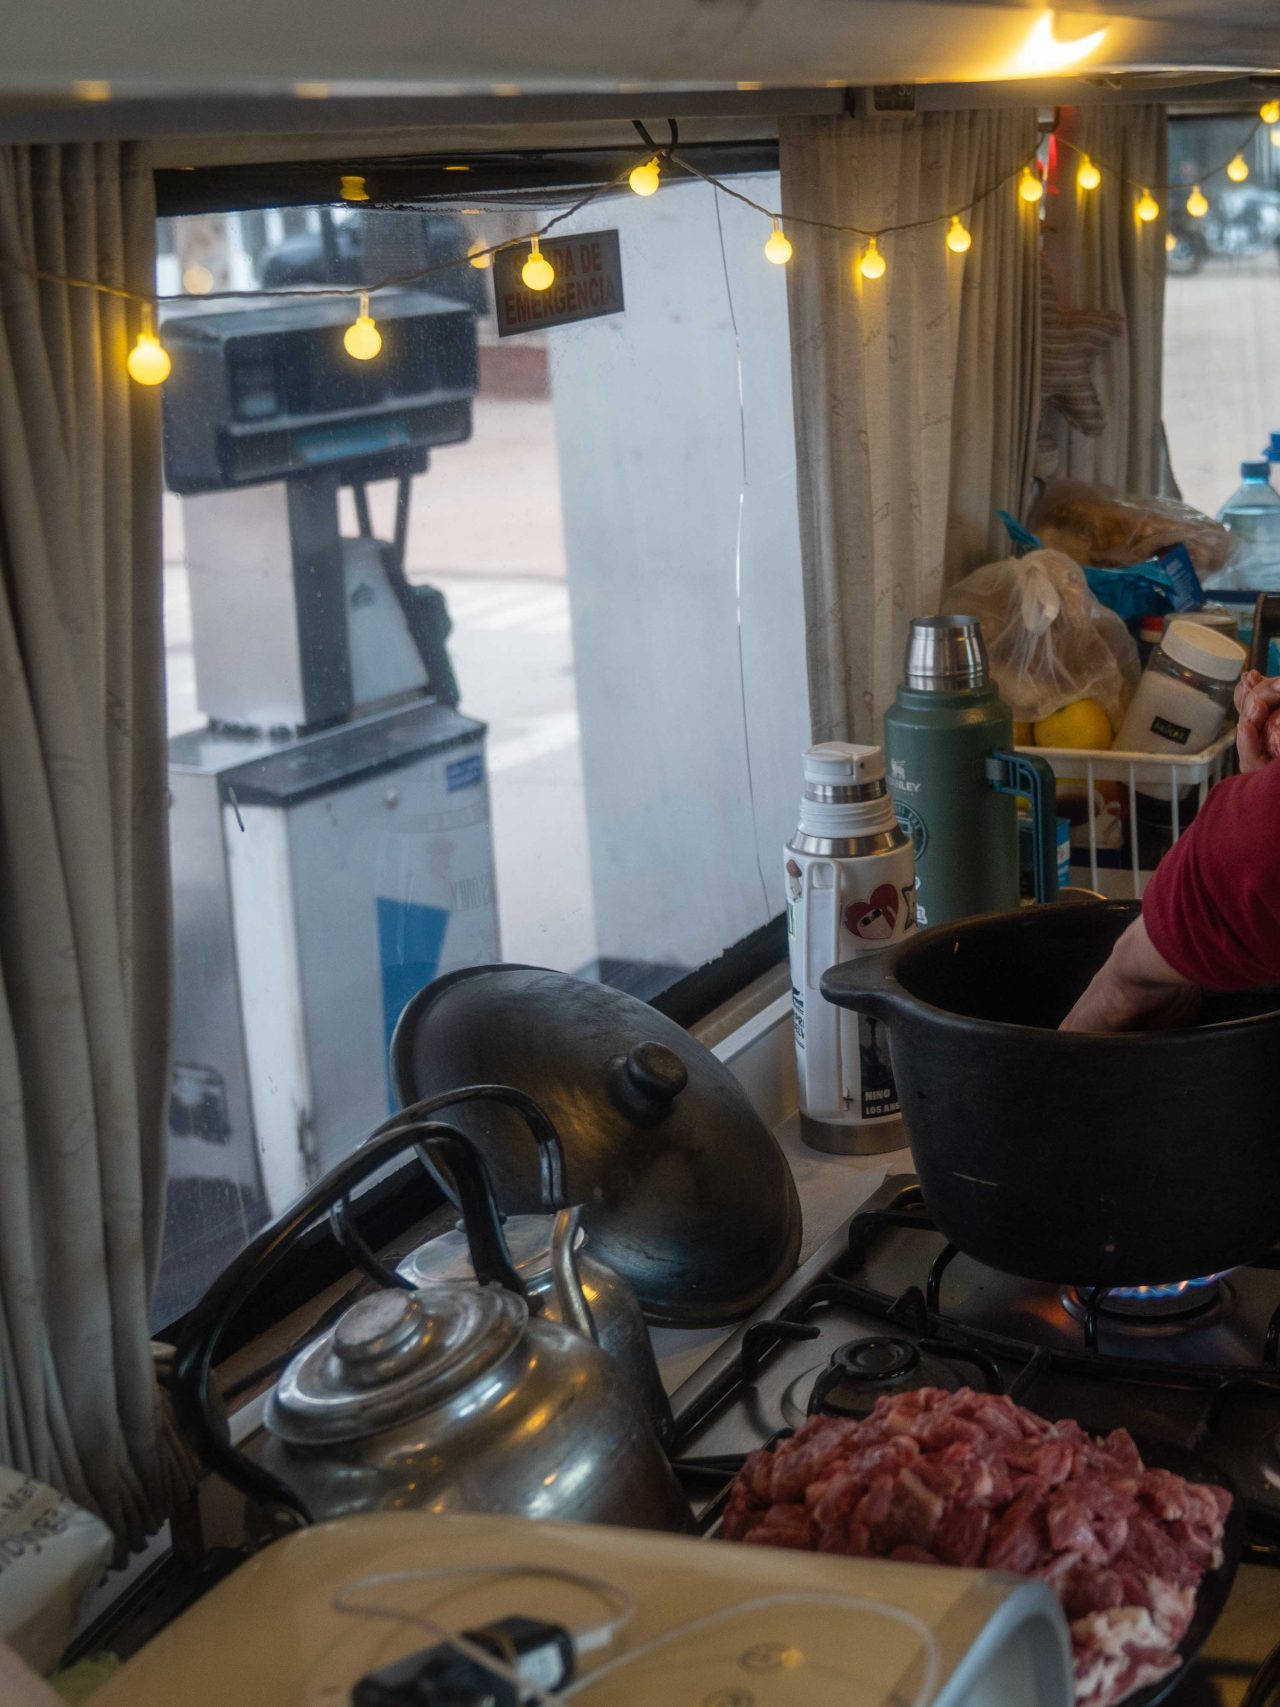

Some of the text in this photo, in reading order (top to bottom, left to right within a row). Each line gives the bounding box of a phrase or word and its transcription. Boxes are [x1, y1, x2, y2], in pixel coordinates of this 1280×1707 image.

[513, 243, 602, 285] SIDA DE
[504, 275, 617, 325] EMERGENCIA
[887, 776, 921, 793] NLEY
[865, 1105, 882, 1116] LOS
